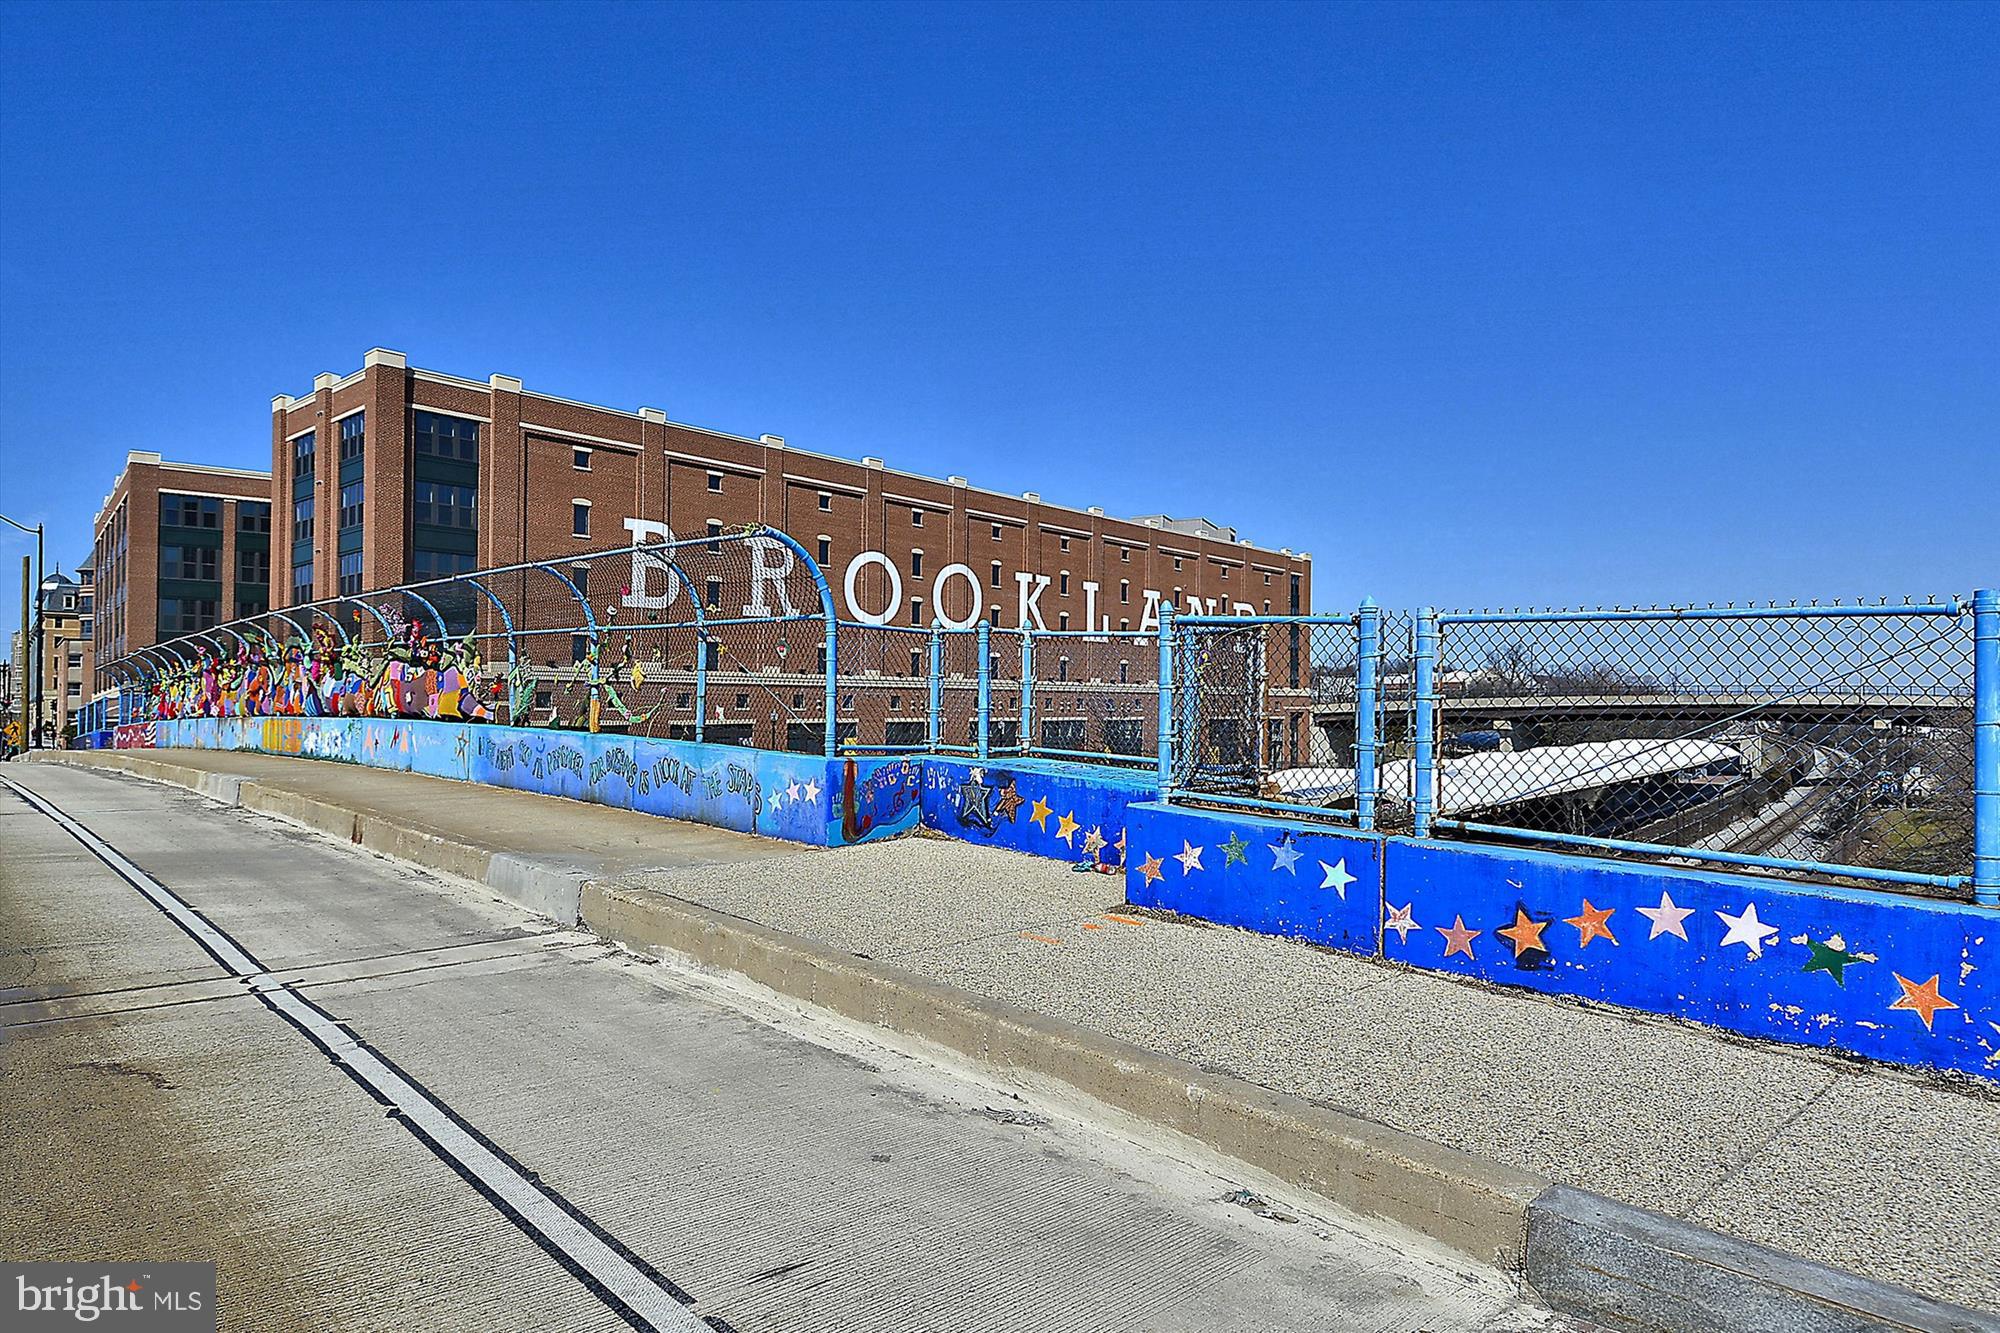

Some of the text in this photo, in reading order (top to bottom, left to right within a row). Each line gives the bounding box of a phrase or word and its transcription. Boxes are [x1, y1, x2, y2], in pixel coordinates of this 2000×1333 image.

[622, 517, 1258, 646] BROOKLA
[680, 766, 696, 796] AT
[702, 770, 722, 800] THE
[727, 763, 762, 816] STARS
